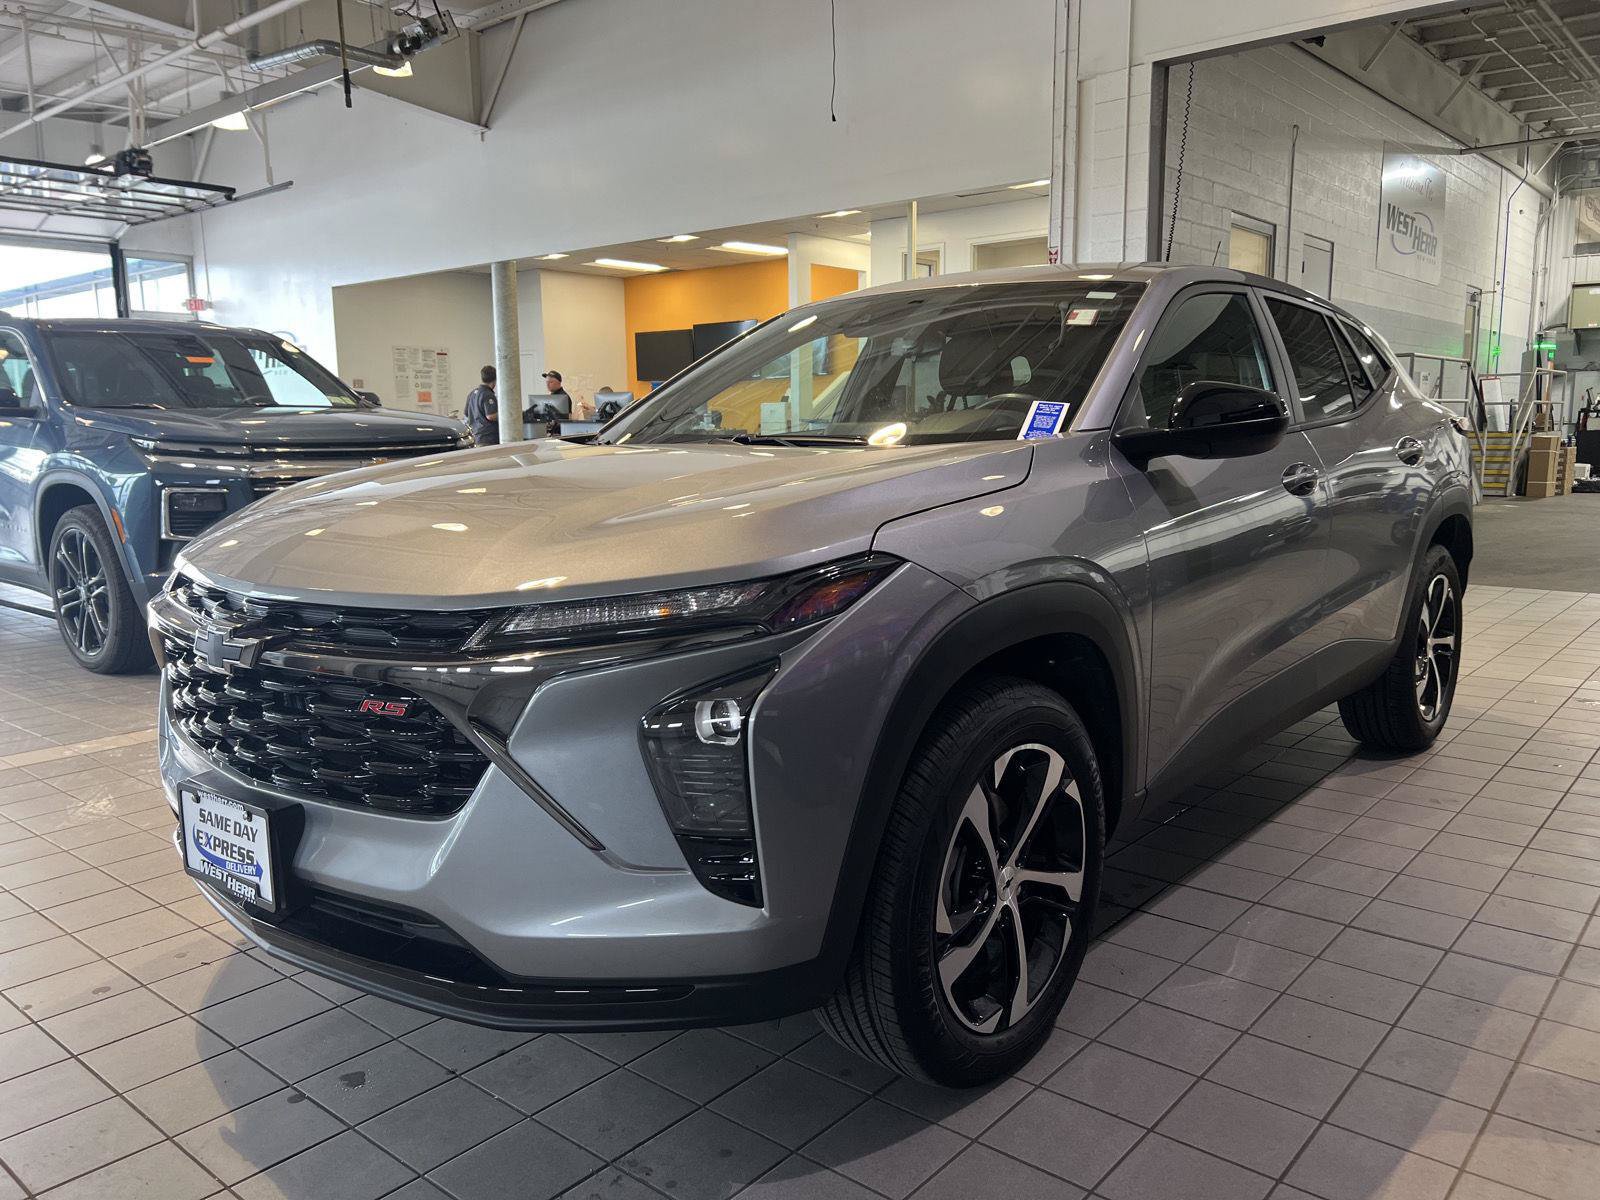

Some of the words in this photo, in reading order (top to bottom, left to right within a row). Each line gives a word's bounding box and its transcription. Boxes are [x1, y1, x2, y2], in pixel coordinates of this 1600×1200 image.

[1386, 203, 1416, 238] WEST
[1412, 225, 1438, 257] HERR
[360, 700, 408, 716] RS
[199, 808, 231, 833] SAME
[233, 821, 258, 842] DAY
[196, 829, 255, 864] EXPRESS
[200, 860, 228, 882] WEST
[227, 876, 256, 900] HERR
[226, 861, 257, 876] DELIVERY
